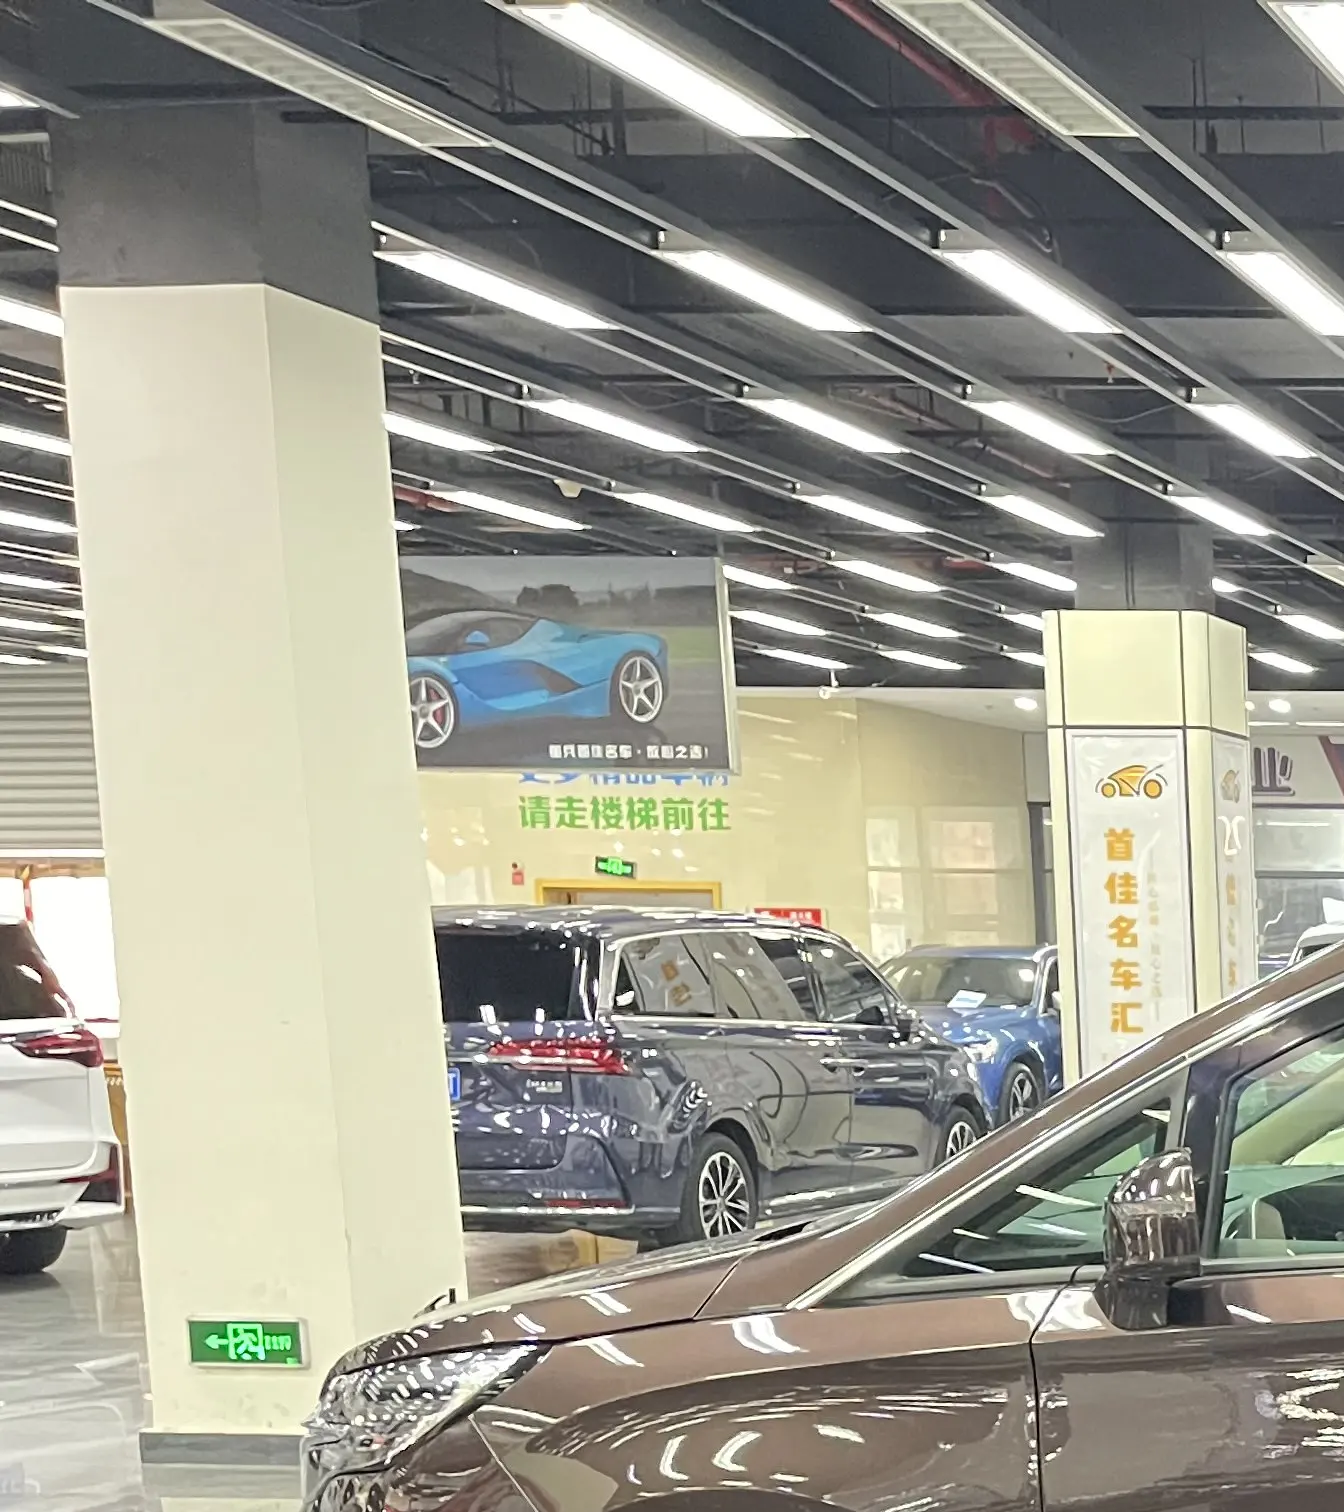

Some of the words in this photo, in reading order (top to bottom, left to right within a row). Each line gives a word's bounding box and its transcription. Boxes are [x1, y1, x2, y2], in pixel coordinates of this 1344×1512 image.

[518, 795, 732, 831] 请走楼梯前往
[1104, 827, 1144, 1034] 首佳名车汇
